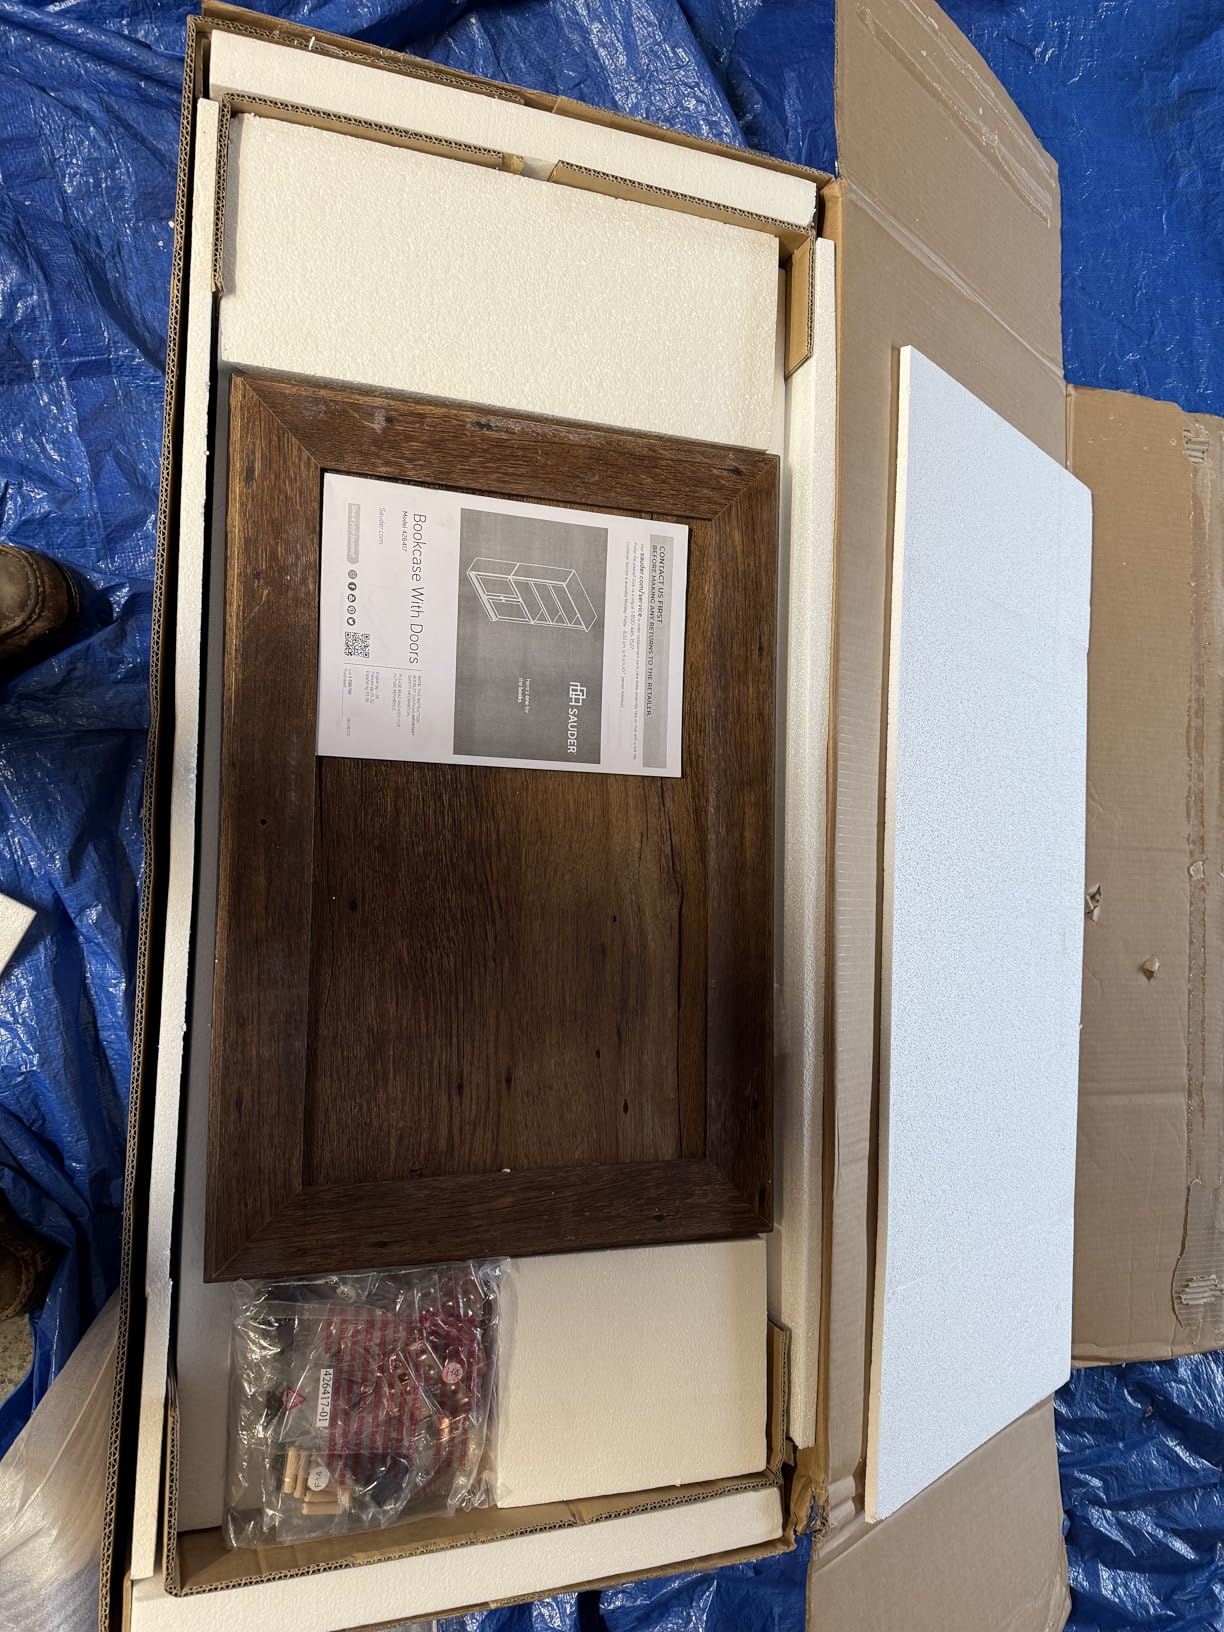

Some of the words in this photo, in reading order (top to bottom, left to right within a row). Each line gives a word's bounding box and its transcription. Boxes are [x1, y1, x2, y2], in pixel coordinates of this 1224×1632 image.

[378, 507, 386, 545] Sauder.com
[412, 513, 427, 582] Bookcase
[658, 546, 666, 586] CONTACT
[411, 586, 424, 618] With
[638, 553, 646, 617] sauder.com/service
[657, 587, 664, 599] US
[409, 623, 424, 664] Doors
[647, 656, 653, 665] TO
[567, 708, 578, 753] SAUDER
[318, 1370, 332, 1422] 426417-01
[314, 1471, 322, 1488] F14
